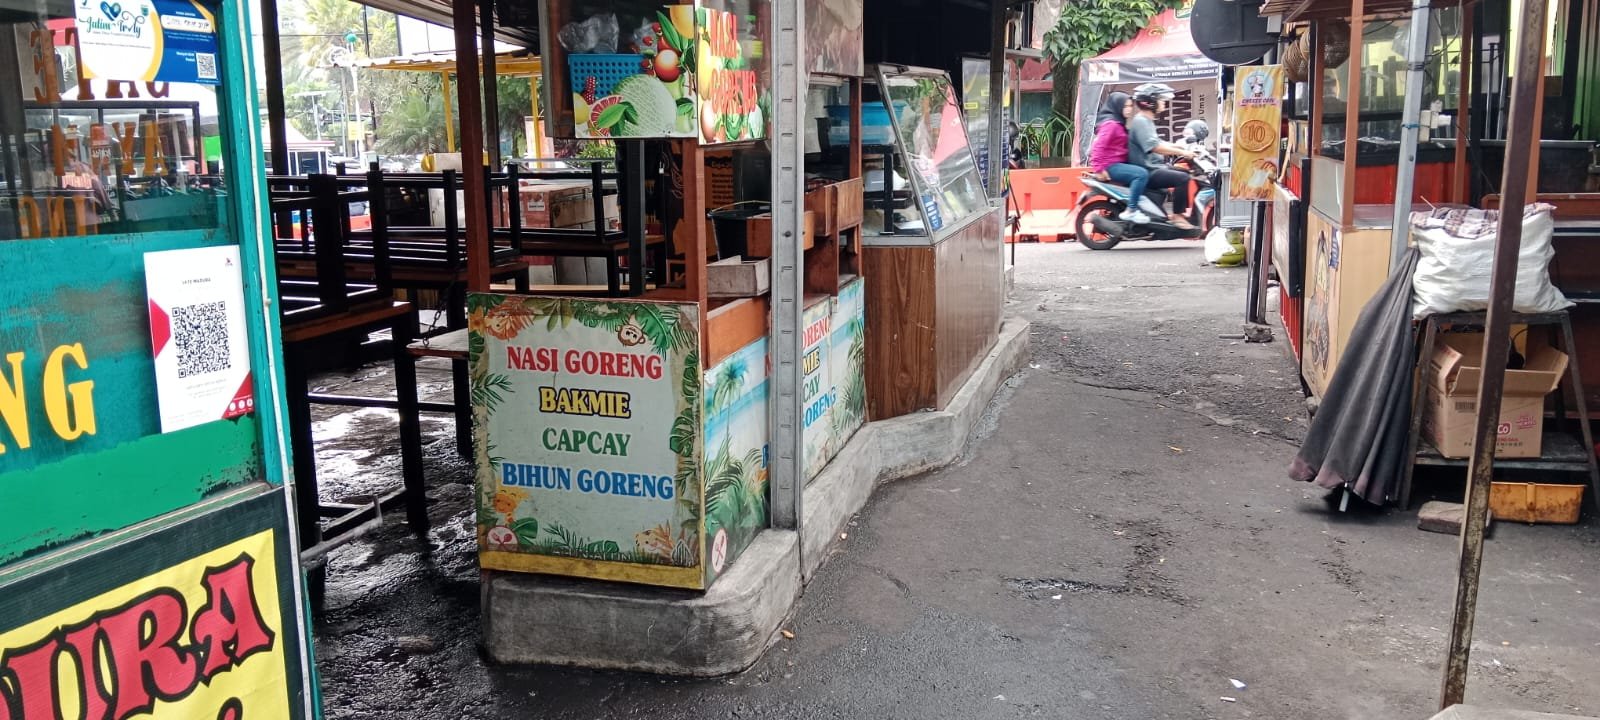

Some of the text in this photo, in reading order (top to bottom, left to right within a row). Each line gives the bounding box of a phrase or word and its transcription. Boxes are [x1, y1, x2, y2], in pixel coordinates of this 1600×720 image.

[710, 9, 737, 57] NASI
[711, 70, 756, 115] GORENG
[507, 346, 662, 379] NASI GORENG
[539, 387, 631, 418] BAKMIE
[542, 427, 631, 456] CAPCAY
[502, 463, 673, 499] BIHUN GORENG
[0, 551, 275, 720] URA
